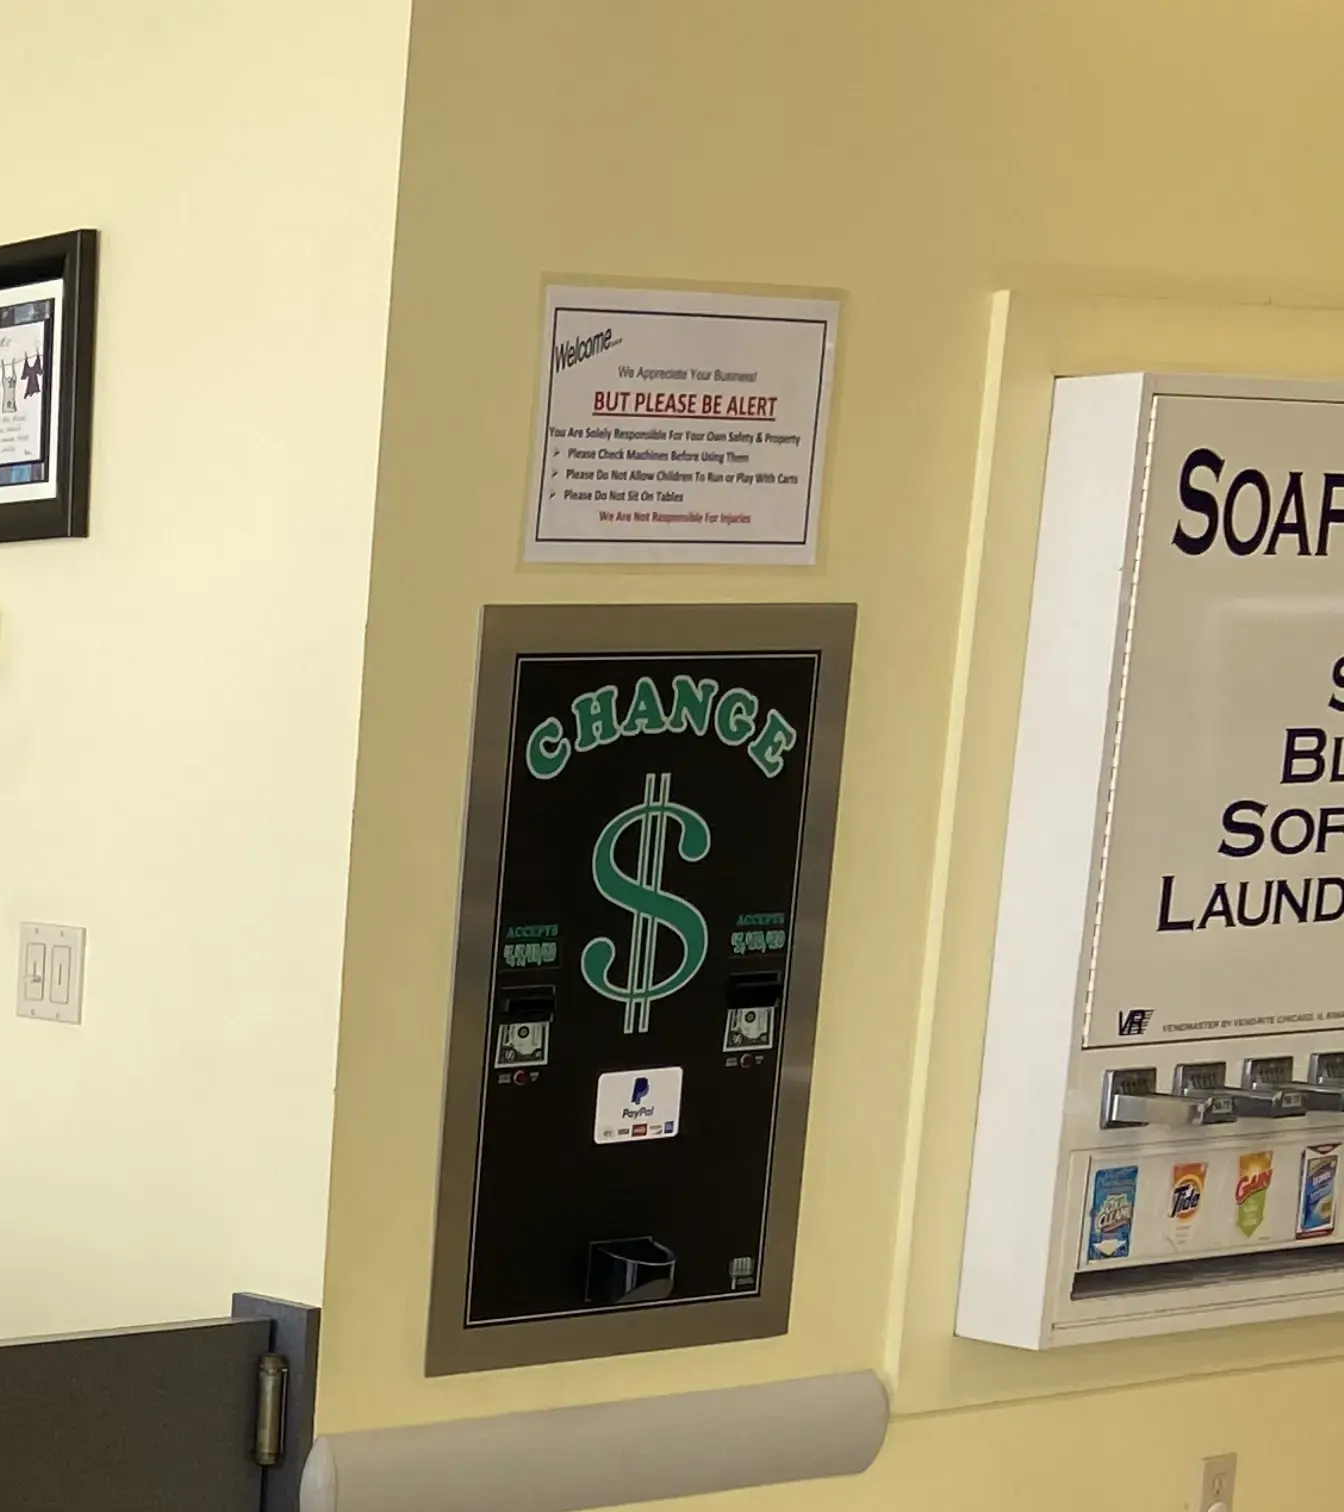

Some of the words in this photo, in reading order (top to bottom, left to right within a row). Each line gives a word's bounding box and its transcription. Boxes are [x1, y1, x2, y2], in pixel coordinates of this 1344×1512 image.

[594, 391, 630, 412] BUT
[634, 392, 697, 413] PLEASE
[701, 394, 723, 414] BE
[726, 396, 778, 416] ALERT
[548, 426, 566, 438] You
[568, 428, 584, 438] Are
[586, 428, 612, 440] Solely
[668, 430, 682, 440] For
[685, 430, 704, 441] Your
[707, 432, 726, 441] Own
[728, 432, 754, 444] Safety
[755, 432, 763, 443] &
[568, 448, 596, 458] Please
[566, 468, 594, 479] Please
[596, 470, 608, 480] Do
[611, 470, 627, 480] Not
[629, 470, 654, 480] Allow
[695, 472, 705, 482] To
[708, 472, 724, 482] Run
[564, 490, 592, 500] Please
[594, 490, 607, 500] Do
[610, 490, 626, 500] Not
[599, 511, 614, 521] We
[616, 512, 632, 522] Are
[634, 512, 650, 522] Not
[525, 675, 797, 780] CHANGE
[622, 1106, 654, 1119] PayPal
[1168, 1184, 1200, 1218] Tide
